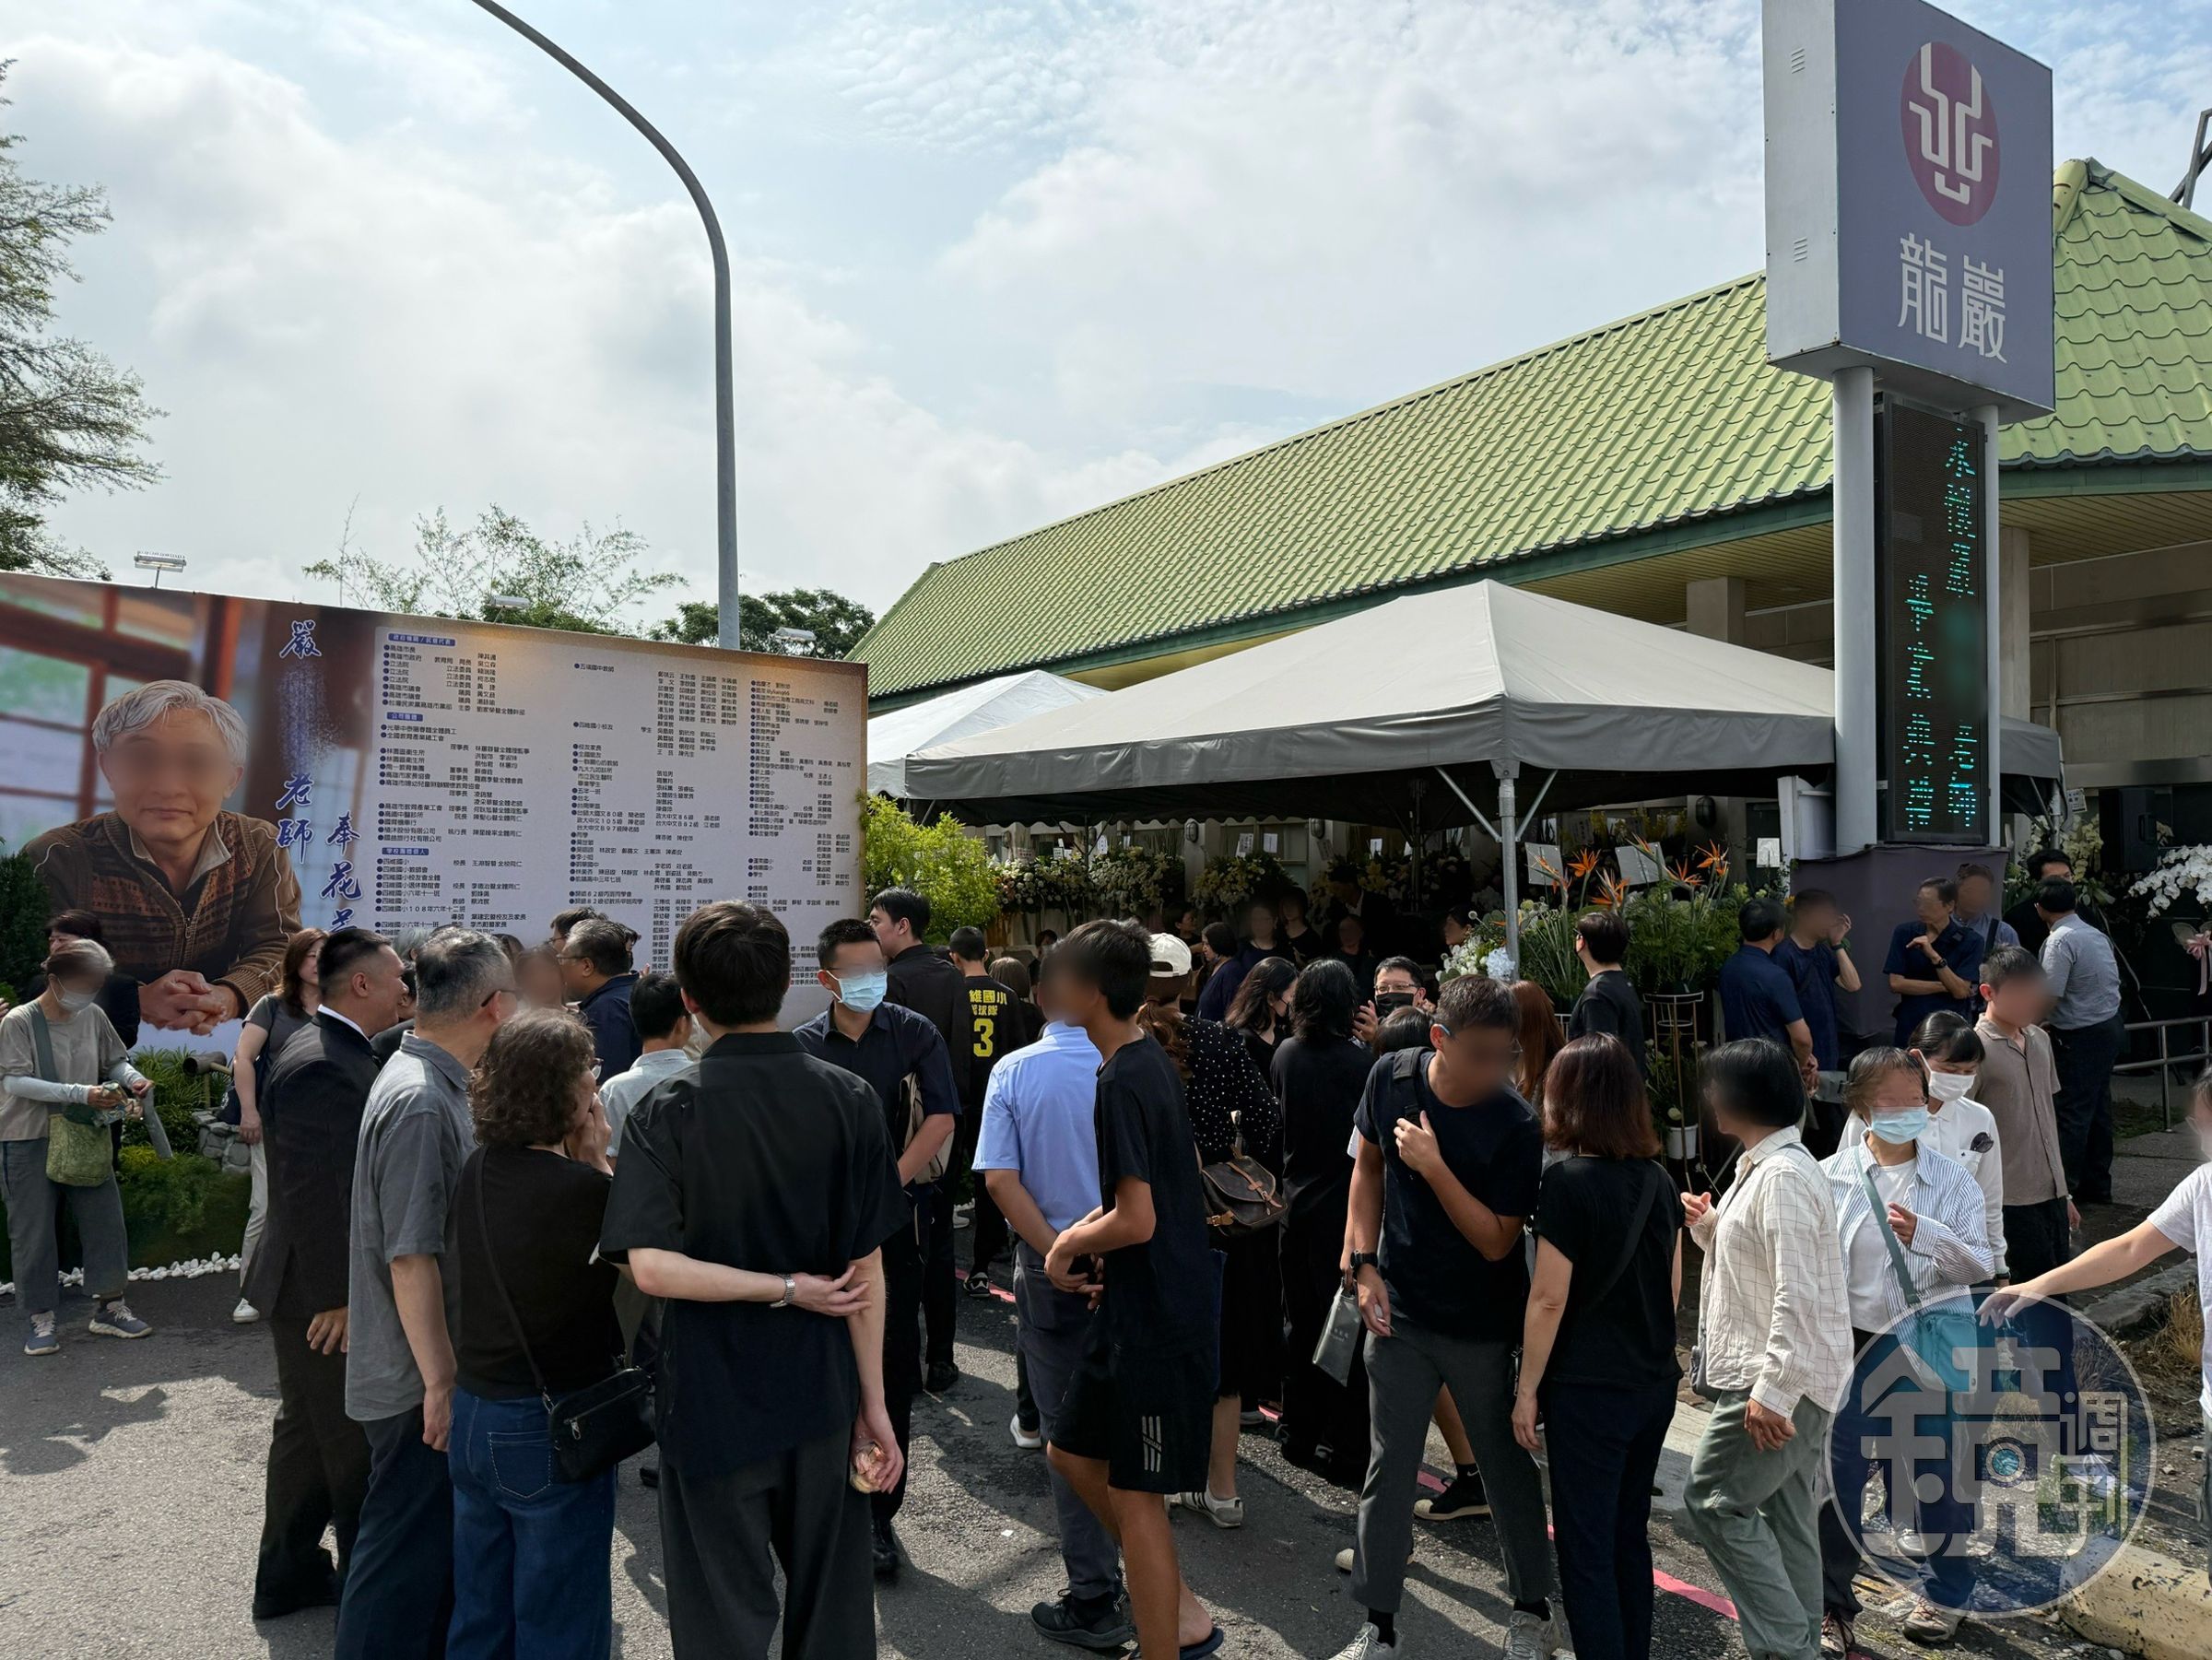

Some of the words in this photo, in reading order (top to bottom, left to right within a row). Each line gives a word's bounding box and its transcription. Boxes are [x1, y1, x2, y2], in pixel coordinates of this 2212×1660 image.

[279, 619, 322, 657] 嚴
[390, 661, 409, 669] 立法院
[446, 665, 471, 674] 立法委員
[446, 681, 471, 689] 立法委員
[450, 743, 469, 751] 理事長
[276, 772, 313, 865] 老師
[973, 1018, 994, 1057] 3
